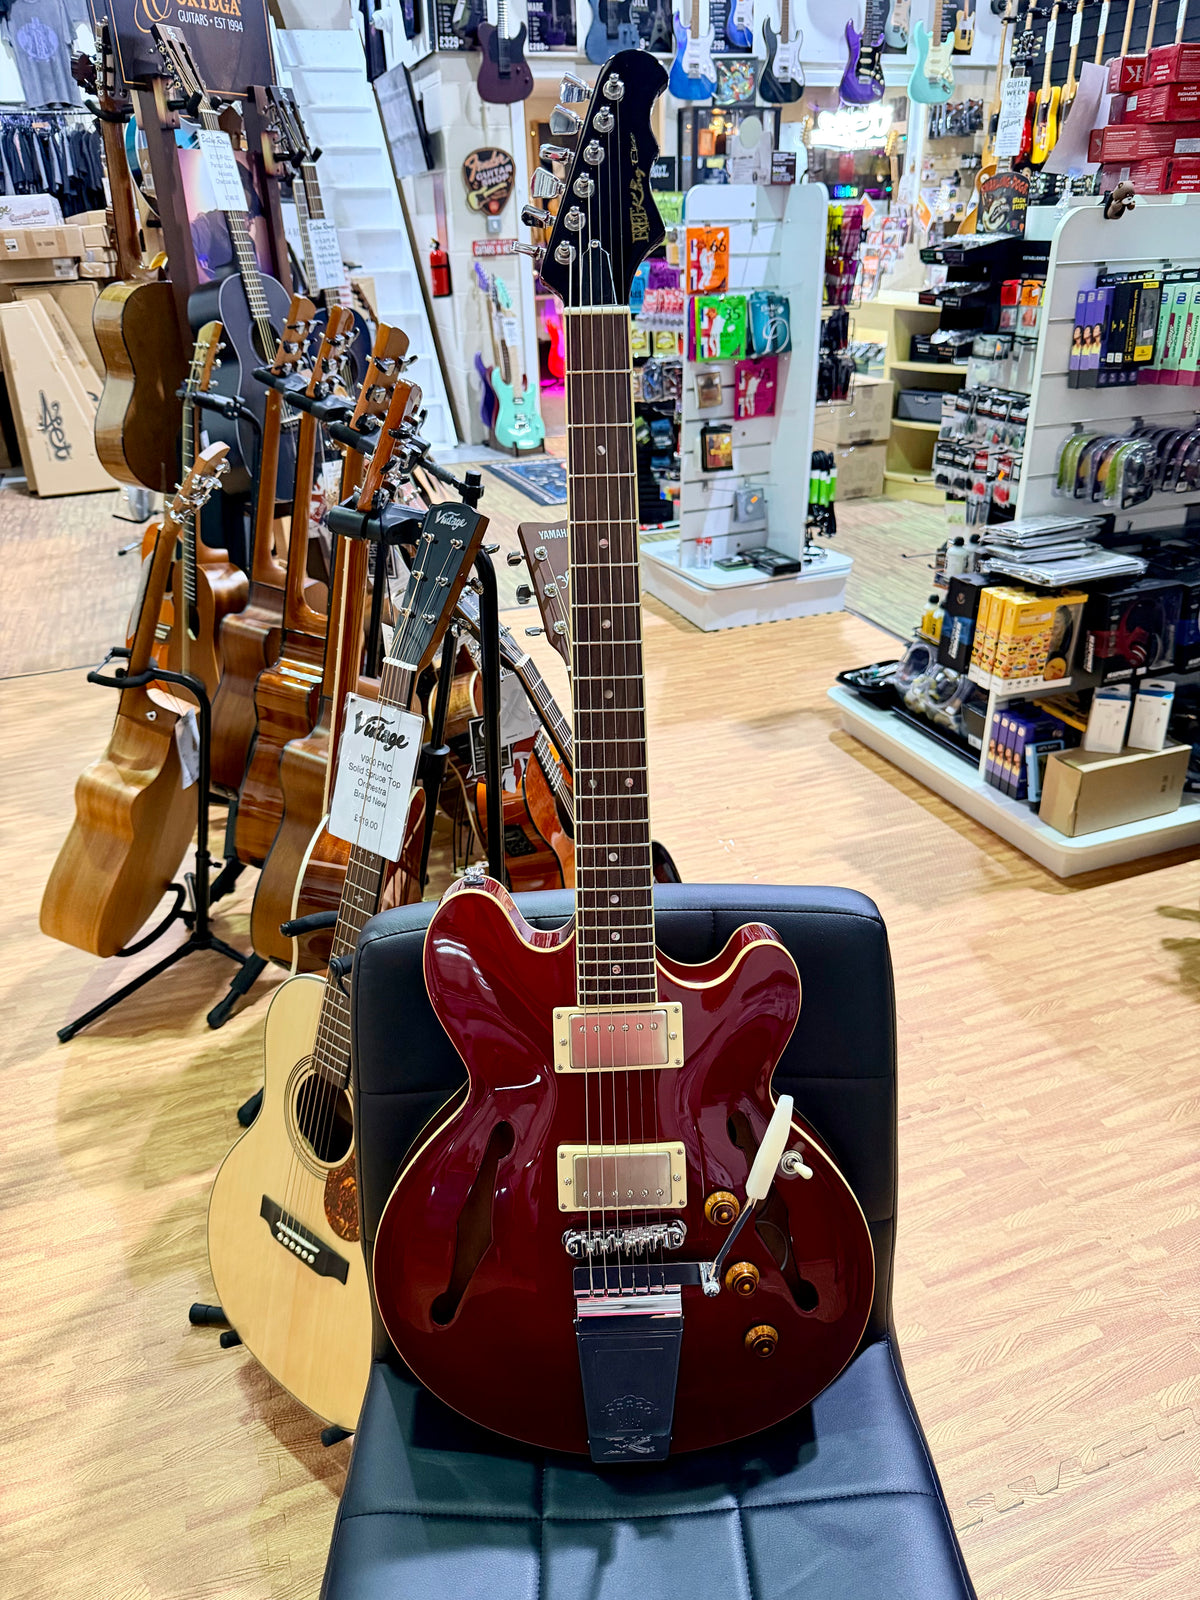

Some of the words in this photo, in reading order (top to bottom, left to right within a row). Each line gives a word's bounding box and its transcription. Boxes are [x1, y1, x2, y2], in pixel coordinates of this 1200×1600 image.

[177, 9, 209, 27] GUITARS
[214, 16, 228, 30] EST
[228, 19, 244, 33] 1994
[1006, 80, 1029, 89] GUITAR
[1006, 89, 1026, 97] WEEK
[476, 163, 513, 181] GUITAR
[709, 239, 726, 254] 66
[434, 510, 468, 531] Vintage
[537, 527, 568, 541] YAMAH
[353, 709, 410, 753] Vintage
[347, 762, 365, 775] Solid
[365, 768, 386, 784] Spruce
[388, 776, 401, 789] Top
[357, 777, 387, 797] Orchestra
[353, 788, 371, 804] Brand
[372, 795, 387, 809] New
